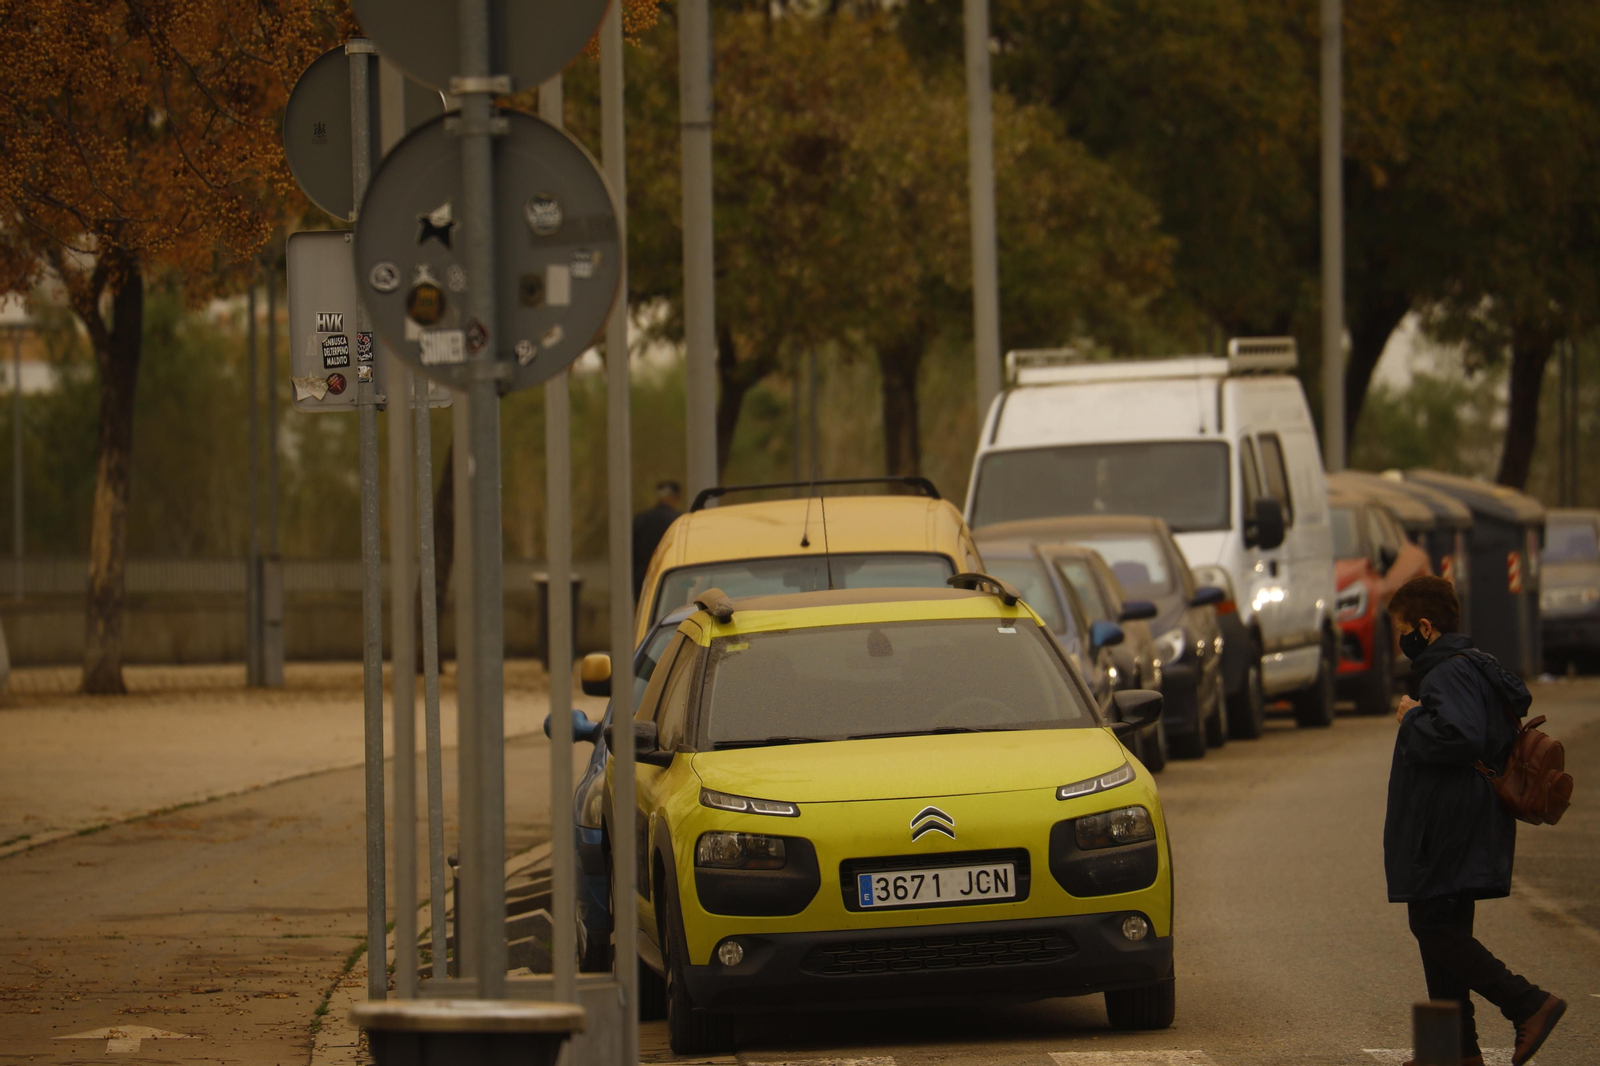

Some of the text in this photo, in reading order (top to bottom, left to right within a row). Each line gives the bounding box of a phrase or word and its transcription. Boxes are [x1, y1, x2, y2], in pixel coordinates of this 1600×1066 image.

[317, 314, 342, 331] HVK
[327, 356, 347, 365] MALDITO
[876, 868, 1010, 901] 3671 JCN
